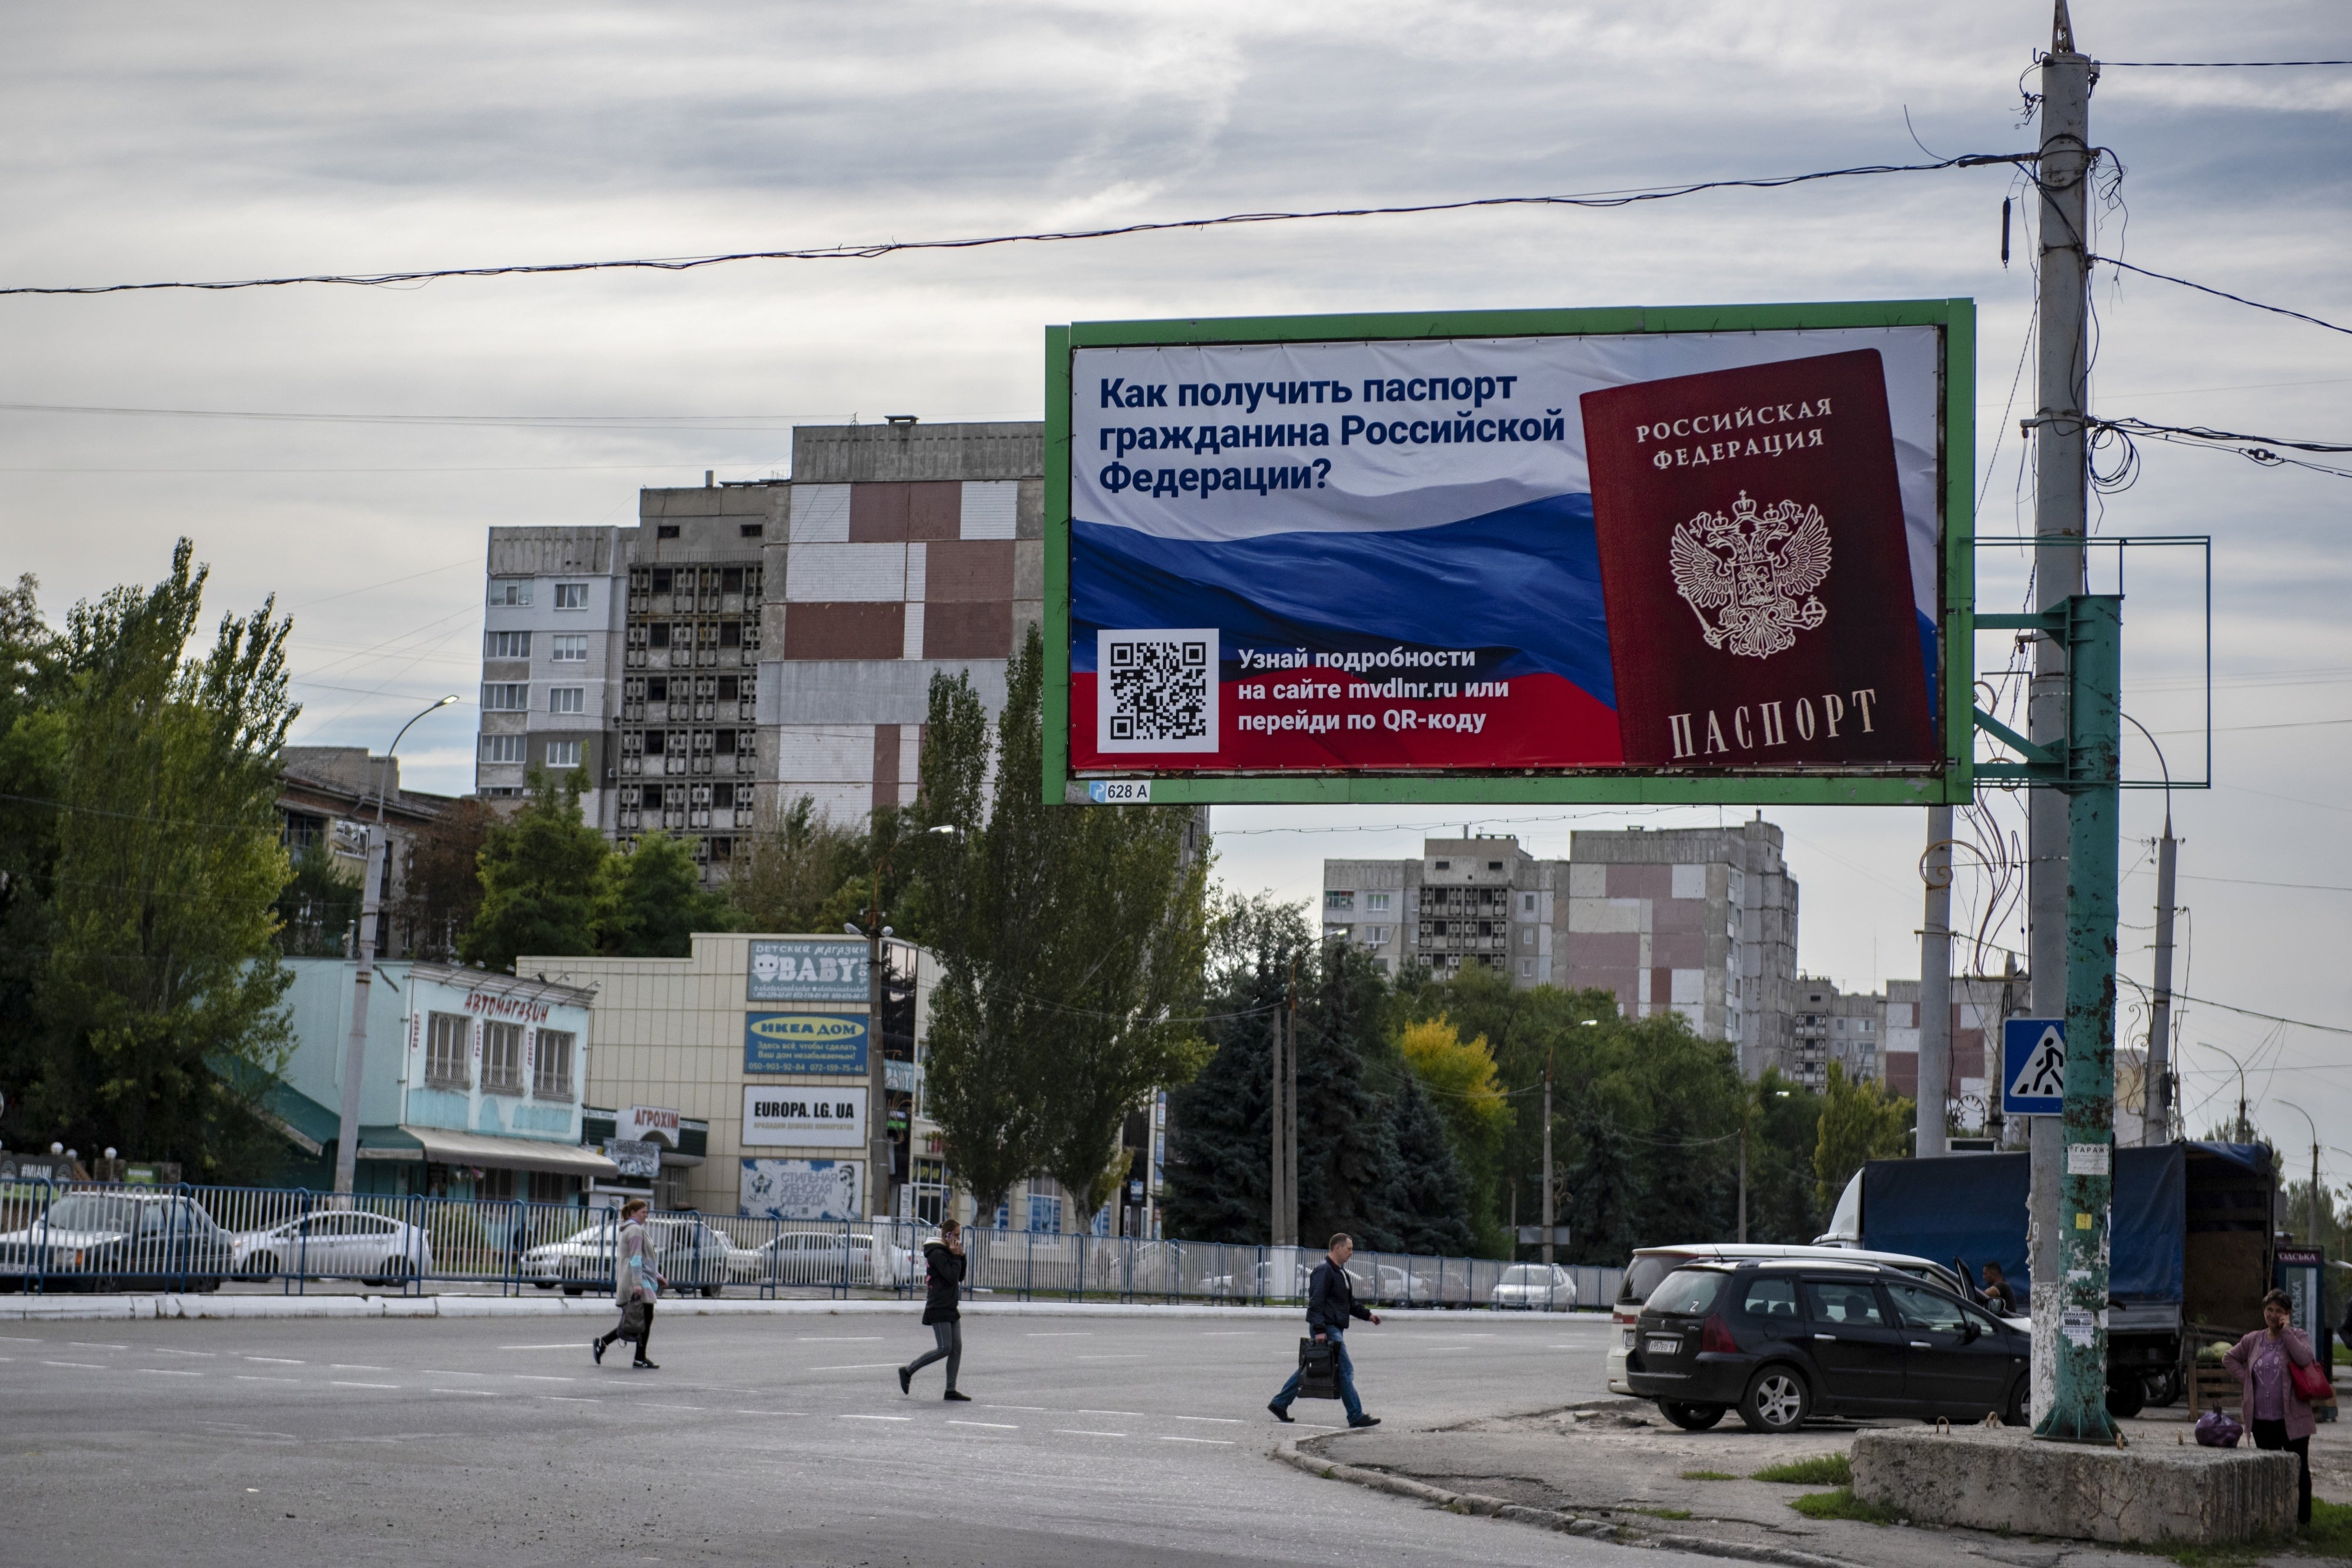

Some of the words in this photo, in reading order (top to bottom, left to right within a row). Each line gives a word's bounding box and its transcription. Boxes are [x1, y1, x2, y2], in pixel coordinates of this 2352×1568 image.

[1100, 377, 1168, 409] Как
[1178, 380, 1352, 413] получить
[1364, 375, 1517, 407] паспорт
[1636, 398, 1832, 443] РОССИЙСКАЯ
[1100, 423, 1329, 458] гражданина
[1341, 409, 1565, 445] Российской
[1653, 429, 1824, 470] ФЕДЕРАЦИЯ
[1100, 459, 1332, 498] Федерации?
[1238, 646, 1308, 669] Узнай
[1315, 650, 1476, 673] подробности
[1238, 681, 1266, 700] на
[1272, 676, 1341, 699] сайте
[1349, 677, 1458, 700] mvdlnr.ru
[1465, 680, 1509, 698] или
[1238, 707, 1338, 734] перейди
[1347, 711, 1375, 730] по
[1383, 708, 1487, 734] QR-коду
[1668, 688, 1876, 759] ПАСПОРТ
[1108, 784, 1132, 798] 628
[1137, 784, 1147, 798] А
[777, 957, 859, 982] BABY
[464, 992, 549, 1024] АВТОМАГАЗИН
[761, 1023, 814, 1033] ИКЕА
[817, 1024, 856, 1036] ДОМ
[757, 1041, 780, 1050] Здесь
[799, 1042, 823, 1050] чтобы
[635, 1108, 679, 1129] АГРОХІМ
[836, 1103, 854, 1118] UA
[21, 1164, 52, 1178] #MIAMI
[781, 1172, 838, 1183] СТИЛЬНАЯ
[780, 1183, 833, 1195] ЖЕНСКАЯ
[780, 1194, 827, 1206] ОДЕЖДА
[2278, 1253, 2316, 1262] ОДСЬКА
[1689, 1301, 1699, 1312] Z
